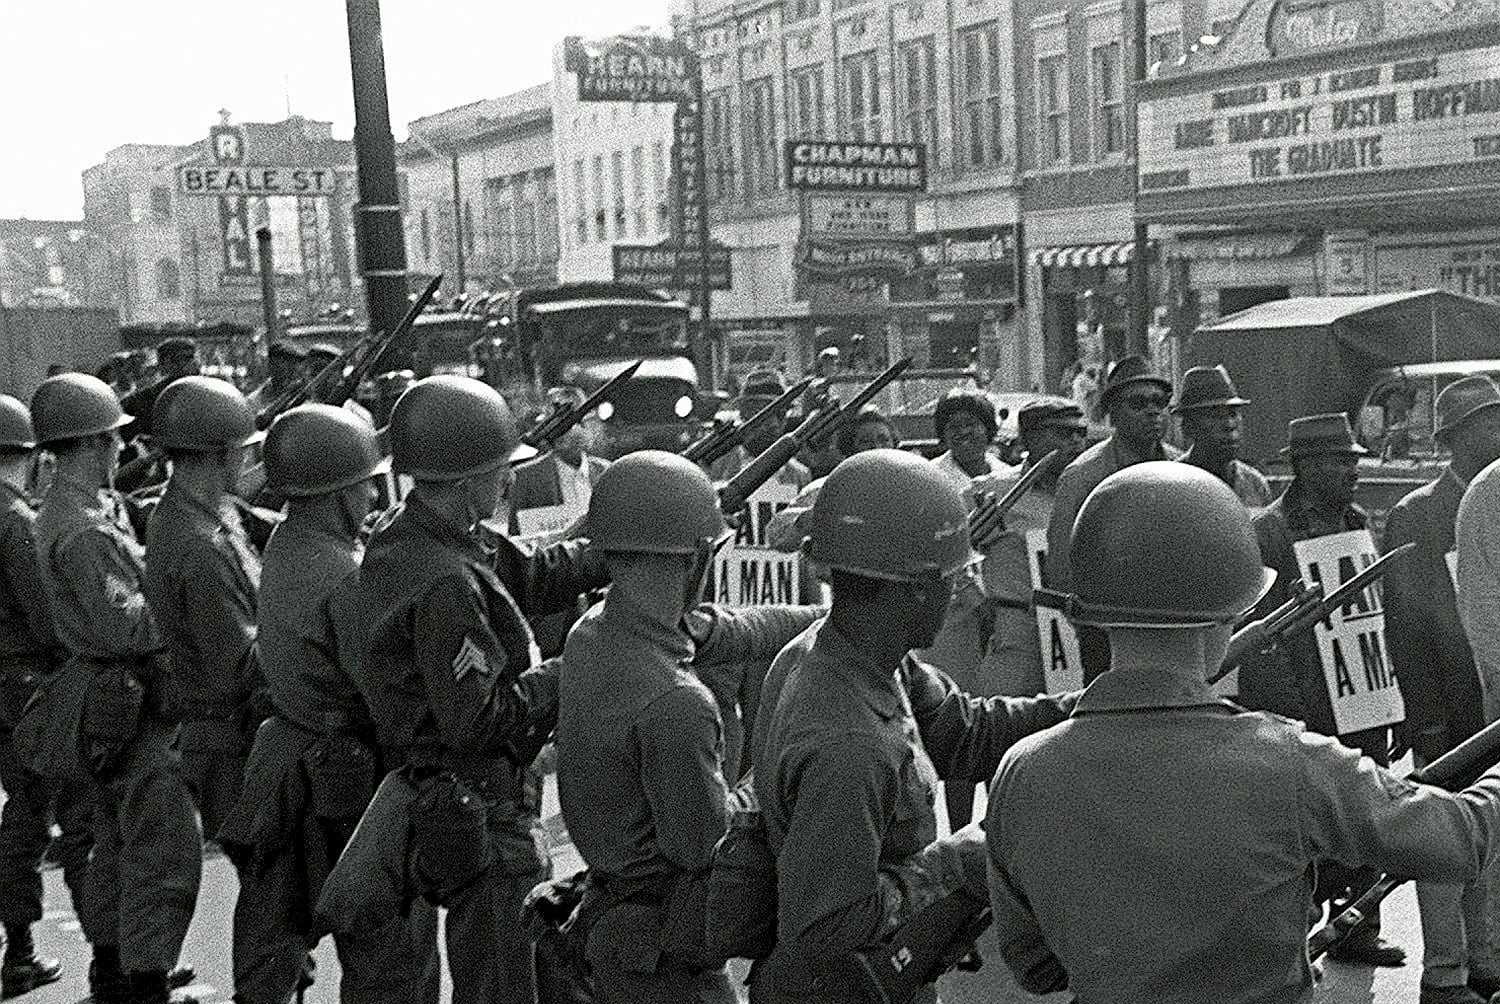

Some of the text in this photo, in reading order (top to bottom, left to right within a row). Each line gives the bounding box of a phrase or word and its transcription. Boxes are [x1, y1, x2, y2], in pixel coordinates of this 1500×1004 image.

[587, 55, 685, 76] HEARN
[1228, 105, 1313, 144] BANCROFT
[1332, 92, 1397, 131] DUSTIN
[792, 166, 922, 187] FURNITURE
[793, 145, 918, 166] CHAPMAN
[1248, 134, 1383, 179] THE GRADUATE
[185, 170, 279, 191] BEALE
[718, 560, 793, 606] A MAN
[1050, 618, 1068, 671] A
[1332, 637, 1356, 698] A
